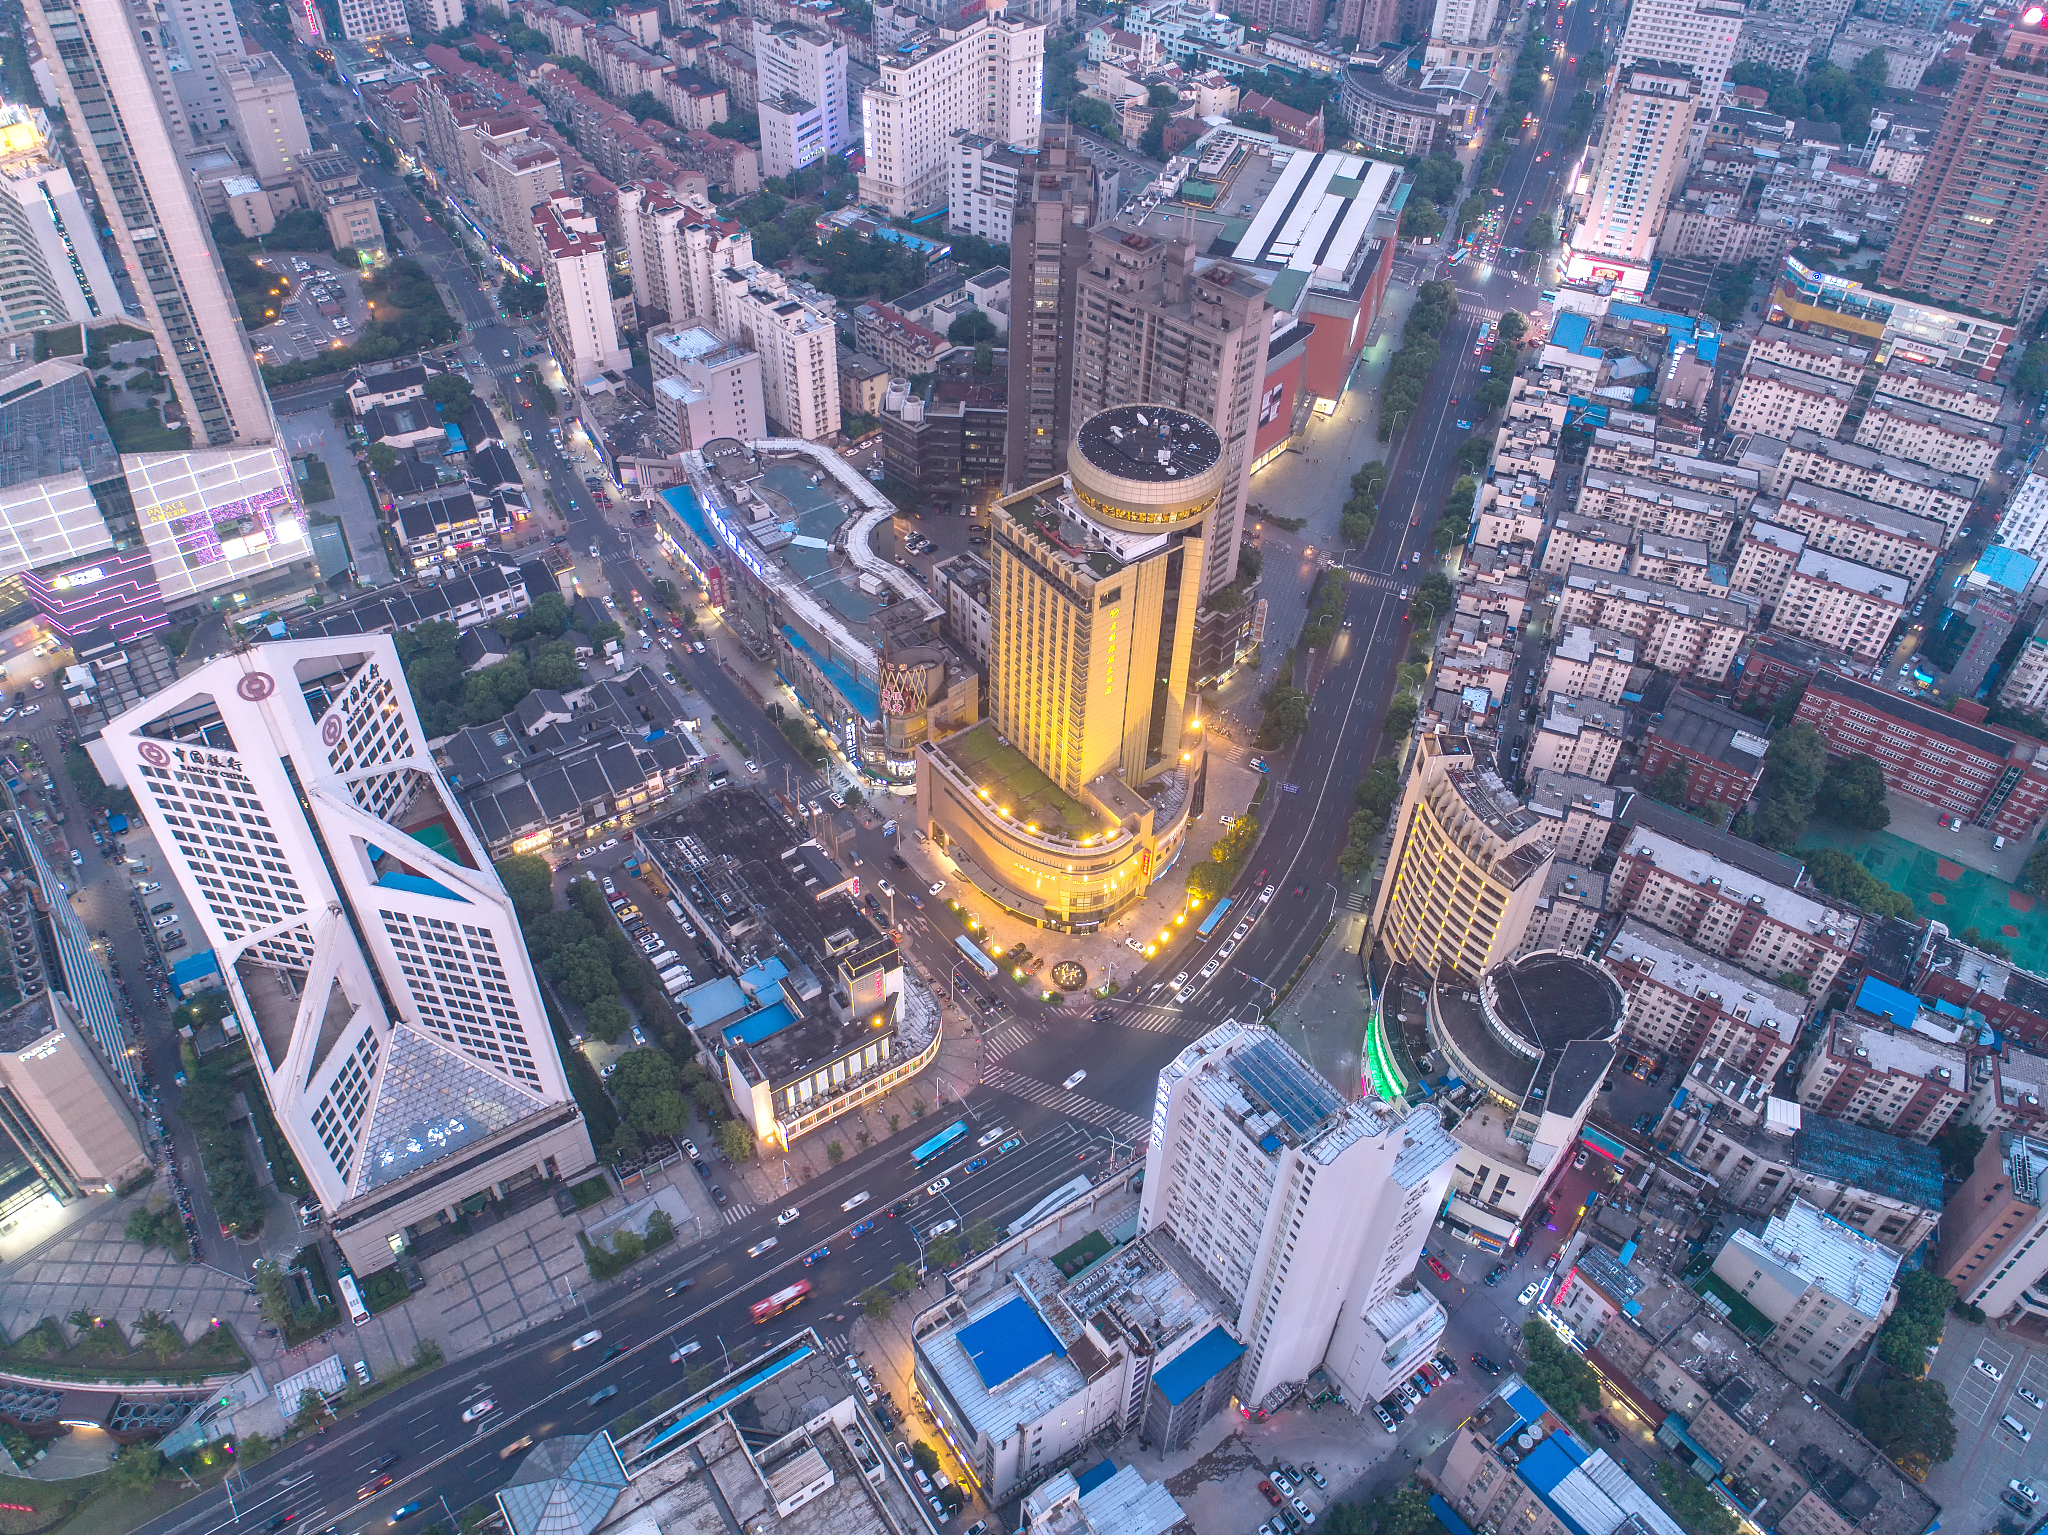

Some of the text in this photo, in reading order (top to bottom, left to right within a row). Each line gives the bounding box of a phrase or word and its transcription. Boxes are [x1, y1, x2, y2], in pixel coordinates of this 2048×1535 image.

[147, 500, 186, 517] PALACE
[340, 663, 380, 715] 中国银行
[346, 677, 385, 727] BANK OF CHINA
[172, 747, 243, 772] 中国银行
[179, 764, 251, 782] BANK OF CHINA
[18, 1032, 67, 1063] PARKSON
